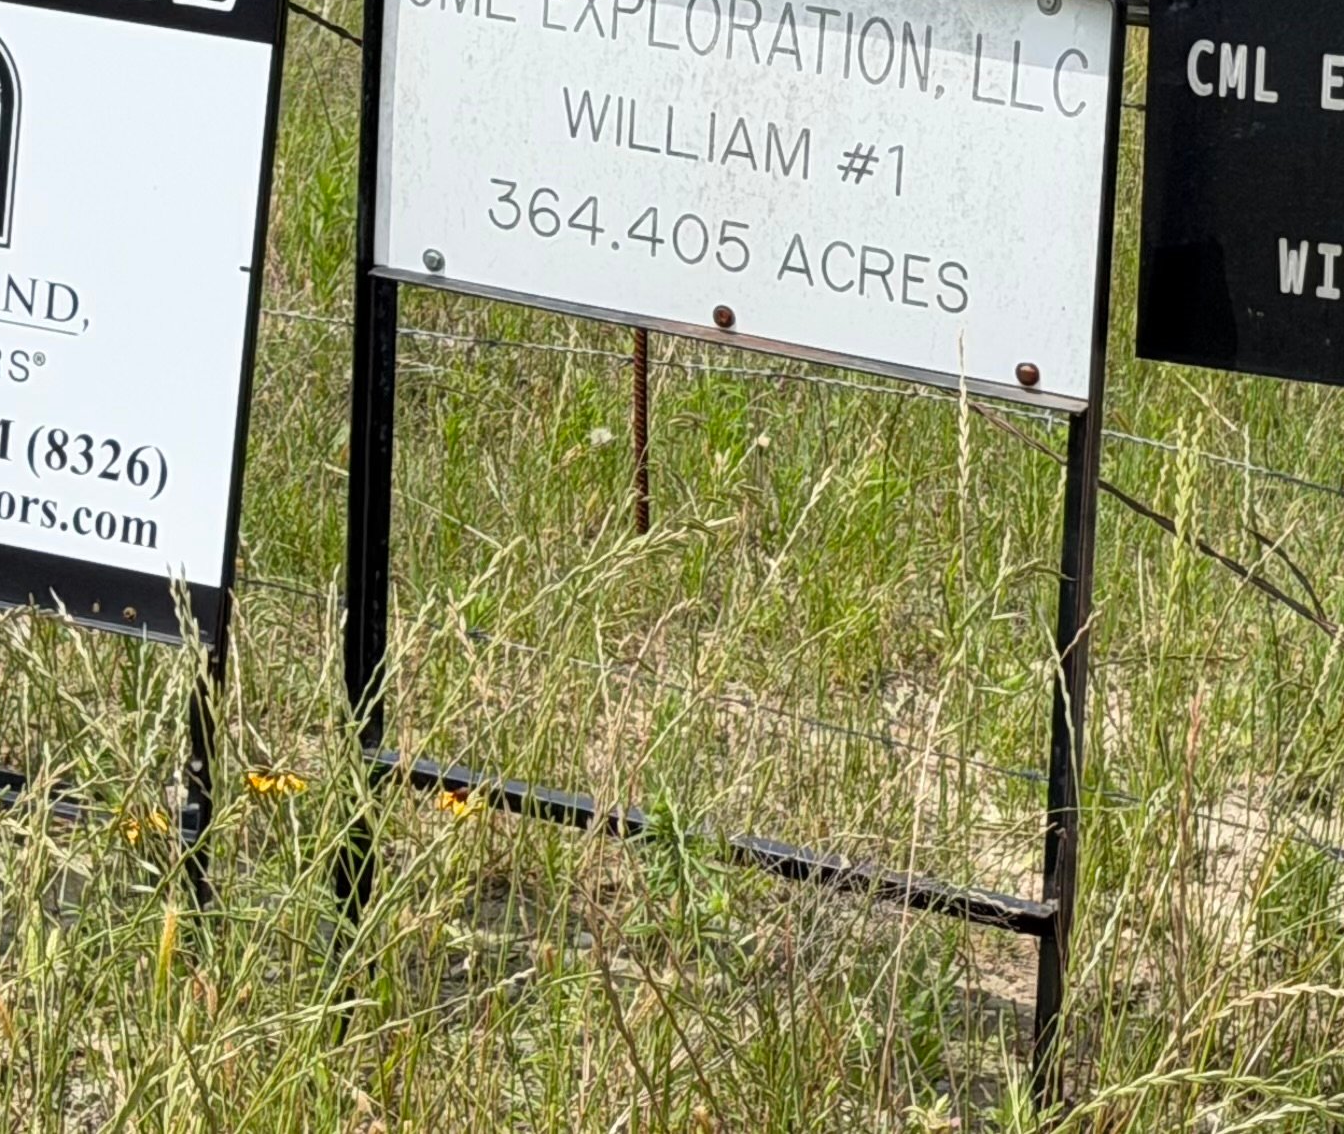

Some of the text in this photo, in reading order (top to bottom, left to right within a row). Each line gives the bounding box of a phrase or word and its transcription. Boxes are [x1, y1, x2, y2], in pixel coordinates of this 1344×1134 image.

[971, 32, 1088, 118] LLC
[1187, 39, 1279, 104] CML
[562, 85, 905, 197] WILLIAM #1
[488, 177, 969, 314] 364.405 ACRES
[25, 422, 170, 502] (8326)
